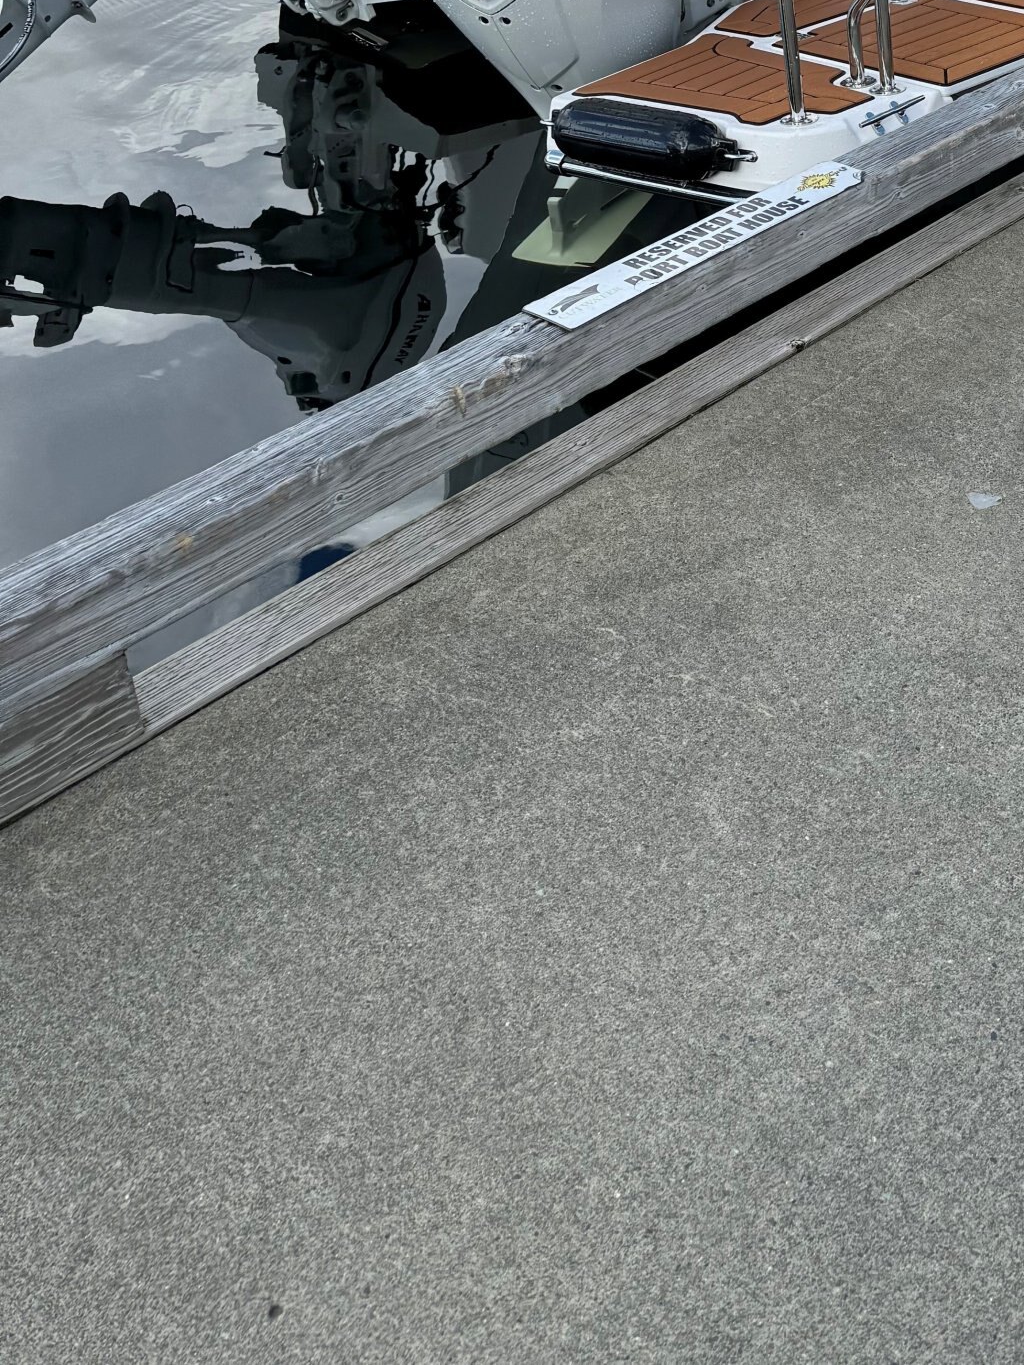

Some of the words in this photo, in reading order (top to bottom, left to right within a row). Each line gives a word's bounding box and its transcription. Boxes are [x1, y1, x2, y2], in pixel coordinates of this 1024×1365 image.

[621, 216, 733, 270] RESERVED
[725, 196, 773, 219] FOR
[624, 254, 690, 287] PORT
[682, 227, 743, 259] BOAT
[736, 195, 811, 231] HOUSE
